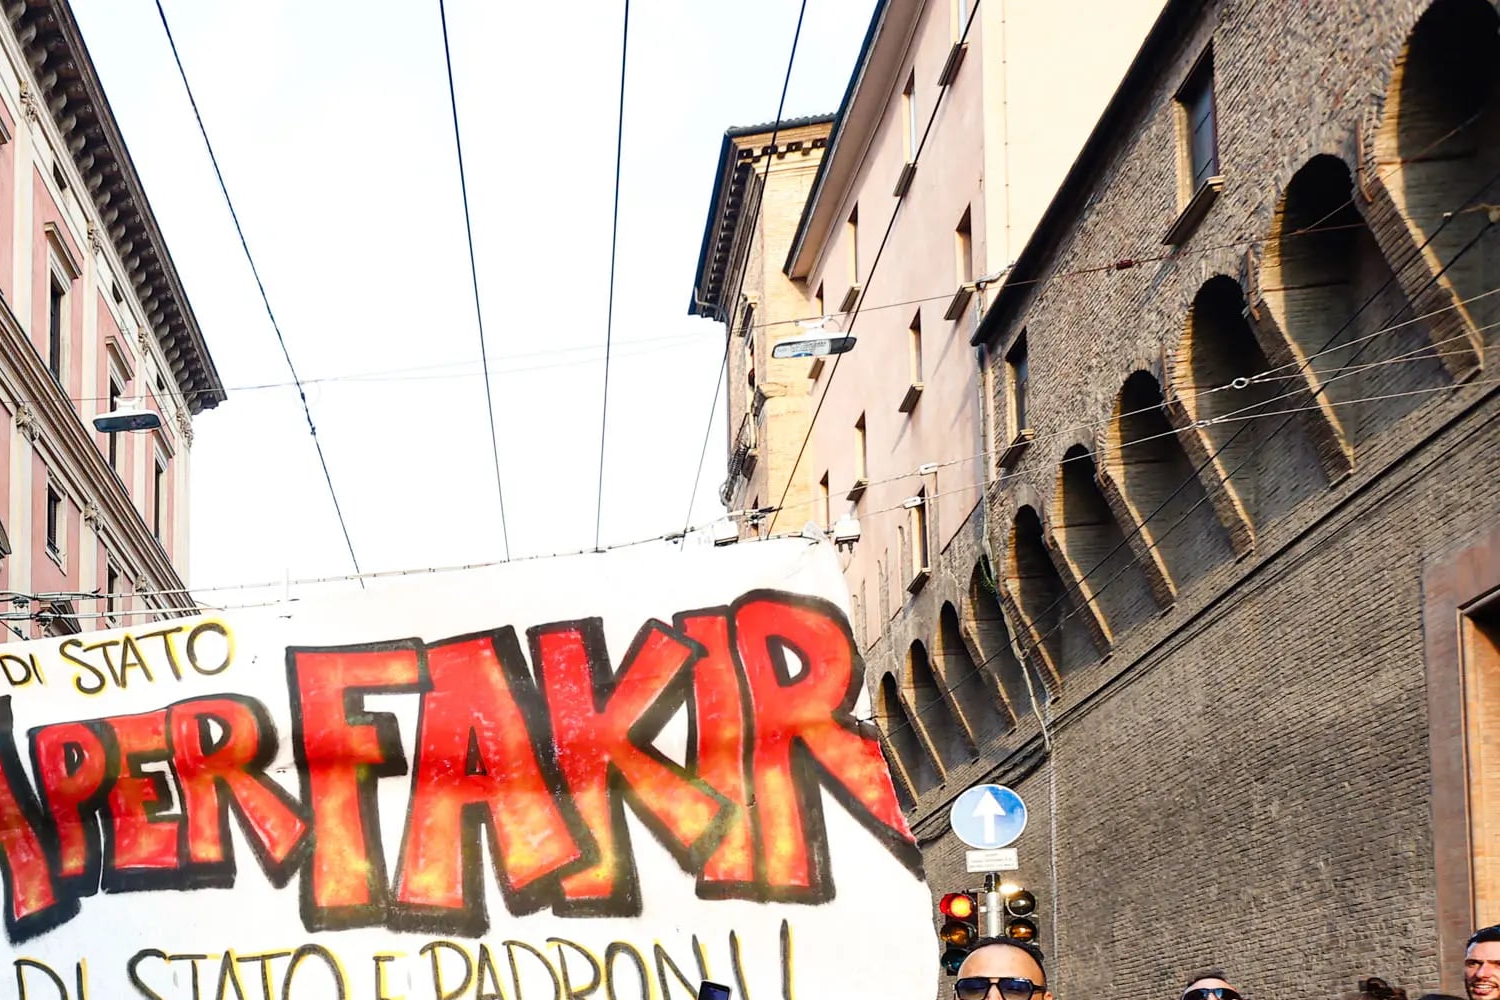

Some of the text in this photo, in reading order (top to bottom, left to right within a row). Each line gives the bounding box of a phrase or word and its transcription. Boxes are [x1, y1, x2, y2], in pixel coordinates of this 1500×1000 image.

[0, 652, 46, 688] DI
[60, 621, 236, 695] STATO
[28, 692, 308, 898] PER
[286, 588, 925, 938] FAKIR
